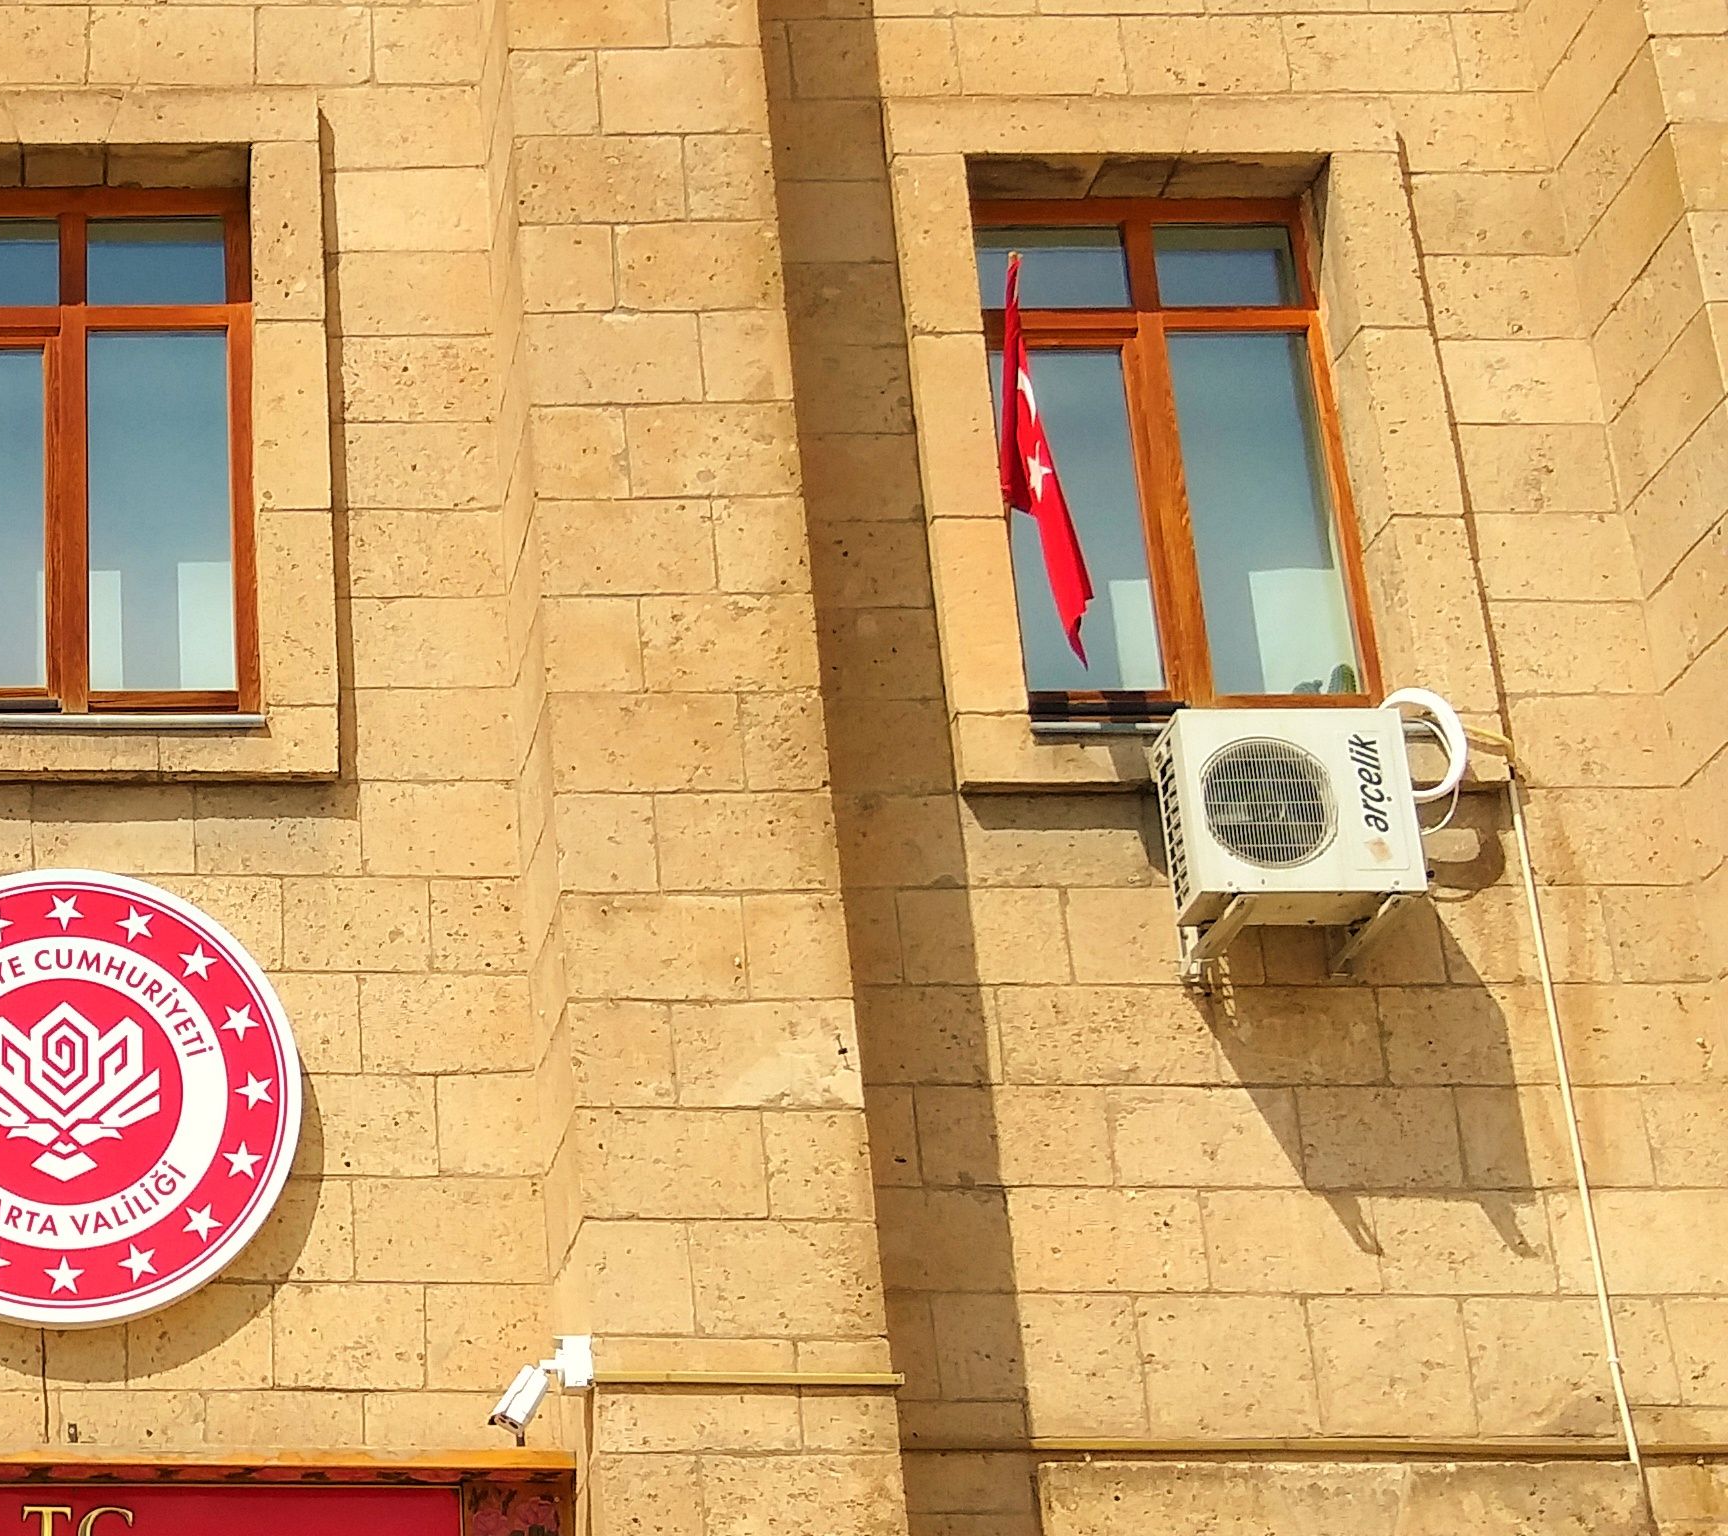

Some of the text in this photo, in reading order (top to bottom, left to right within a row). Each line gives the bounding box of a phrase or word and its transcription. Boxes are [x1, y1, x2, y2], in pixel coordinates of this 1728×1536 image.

[1347, 733, 1392, 833] arçelik
[35, 948, 214, 1058] CUMHURİYETİ
[69, 1159, 187, 1236] VALİLİĞİ
